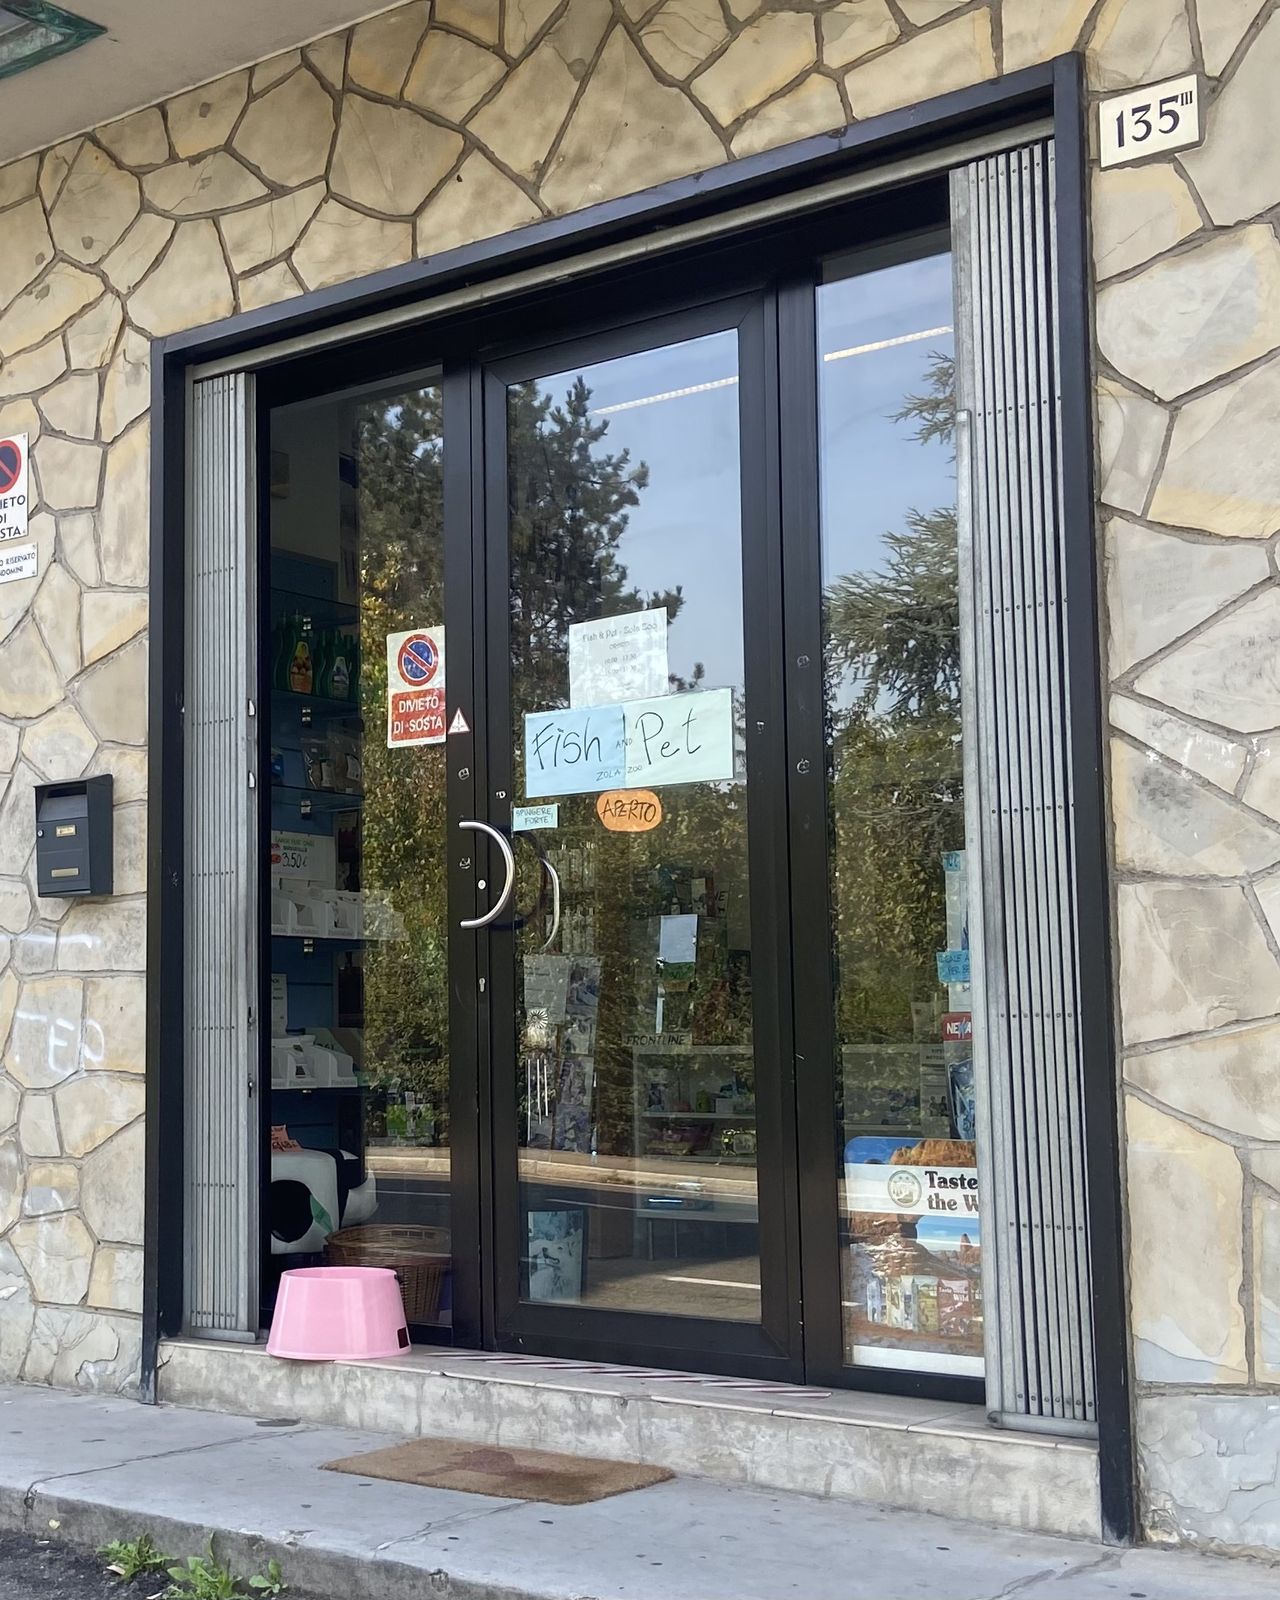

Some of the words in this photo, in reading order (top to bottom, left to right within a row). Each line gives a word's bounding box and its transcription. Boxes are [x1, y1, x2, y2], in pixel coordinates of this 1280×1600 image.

[0, 494, 26, 509] IETO
[0, 525, 21, 539] STA
[5, 552, 36, 565] RISERVATO
[398, 696, 439, 713] DIVIETO
[393, 720, 404, 734] DI
[408, 715, 443, 732] SOSTA
[531, 716, 602, 770] Fish
[615, 737, 633, 750] AND
[634, 707, 702, 765] Pet
[596, 768, 621, 781] ZOLA
[627, 764, 643, 774] ZOO
[600, 798, 657, 823] APERTO
[626, 1033, 686, 1046] FRONTLINE
[924, 1170, 978, 1190] Taste
[927, 1193, 958, 1211] the
[963, 1194, 979, 1212] W
